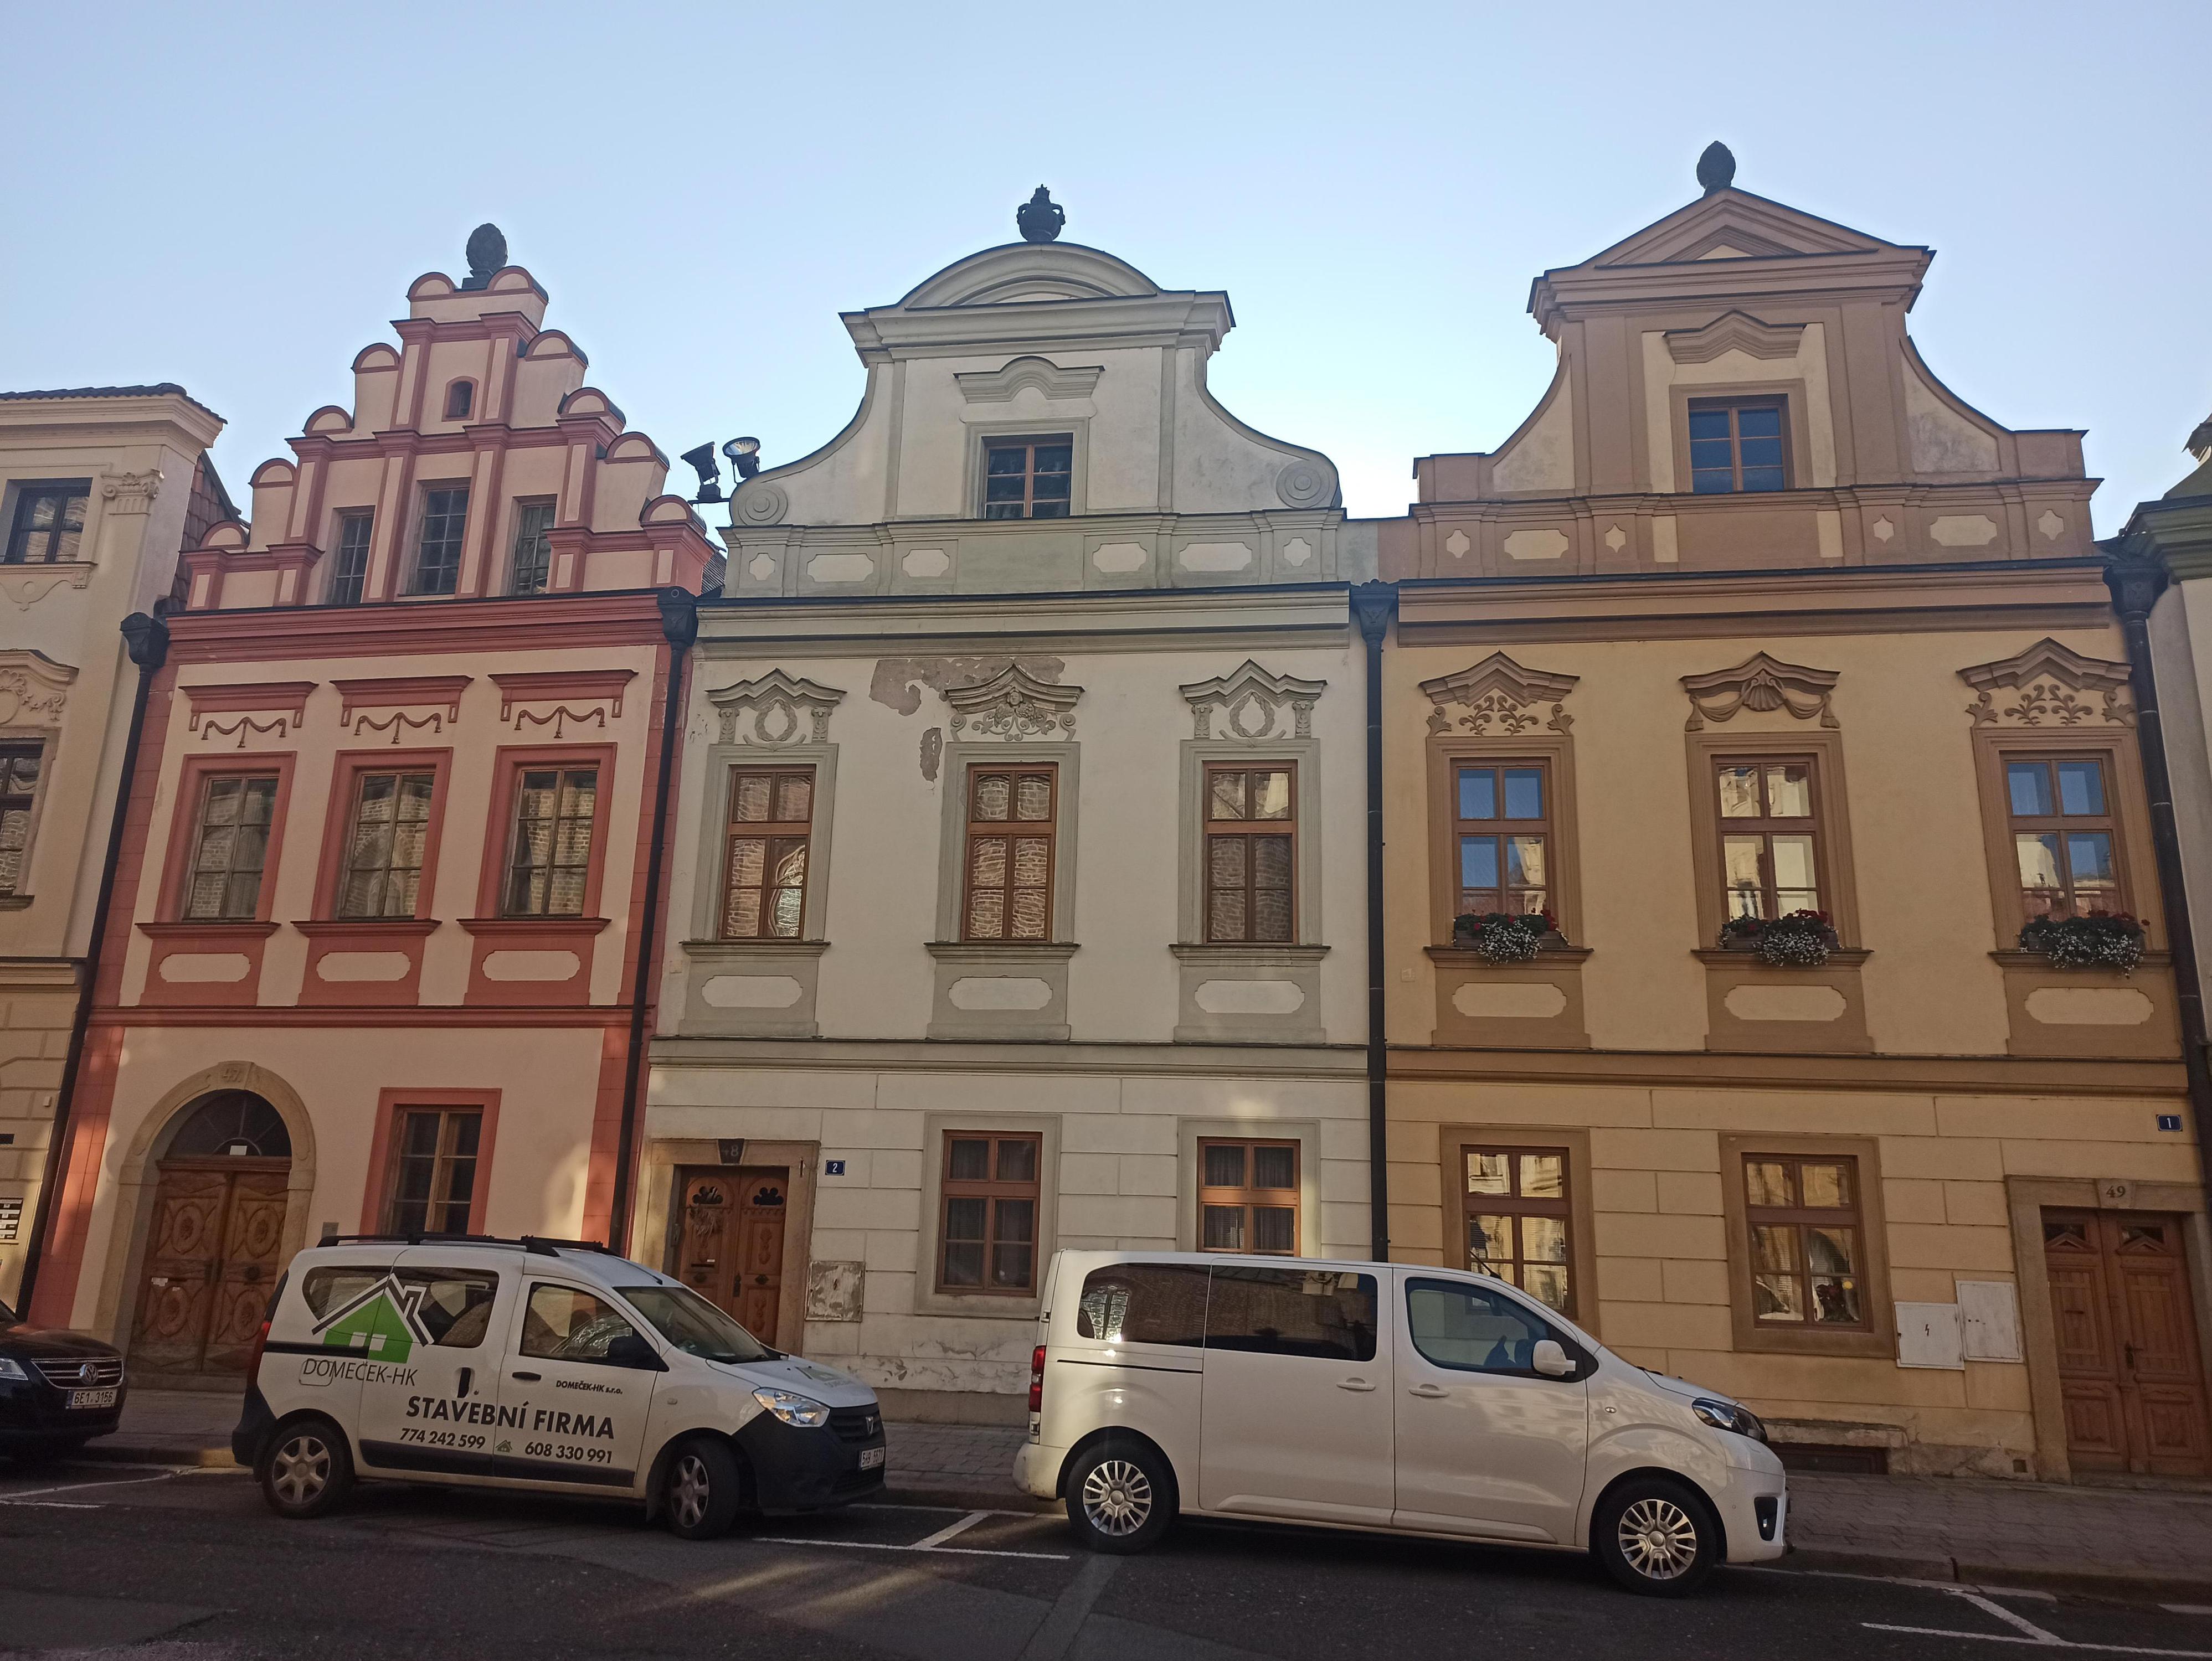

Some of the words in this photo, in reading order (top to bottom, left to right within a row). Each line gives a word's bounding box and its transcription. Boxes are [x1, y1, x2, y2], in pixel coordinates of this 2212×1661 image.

[2167, 1117, 2172, 1128] 1
[832, 1163, 838, 1173] 2
[2106, 1185, 2126, 1198] 49
[303, 1358, 418, 1386] DOMEČEK-HK
[555, 1380, 605, 1392] DOMEČEK-HK
[74, 1392, 90, 1404] 6E1
[406, 1396, 529, 1430] STAVEBNÍ
[533, 1410, 614, 1440] FIRMA
[401, 1427, 425, 1443] 774
[429, 1431, 455, 1446] 242
[457, 1435, 486, 1449] 599
[524, 1442, 553, 1457] 608
[555, 1445, 584, 1461] 330
[587, 1448, 612, 1464] 991
